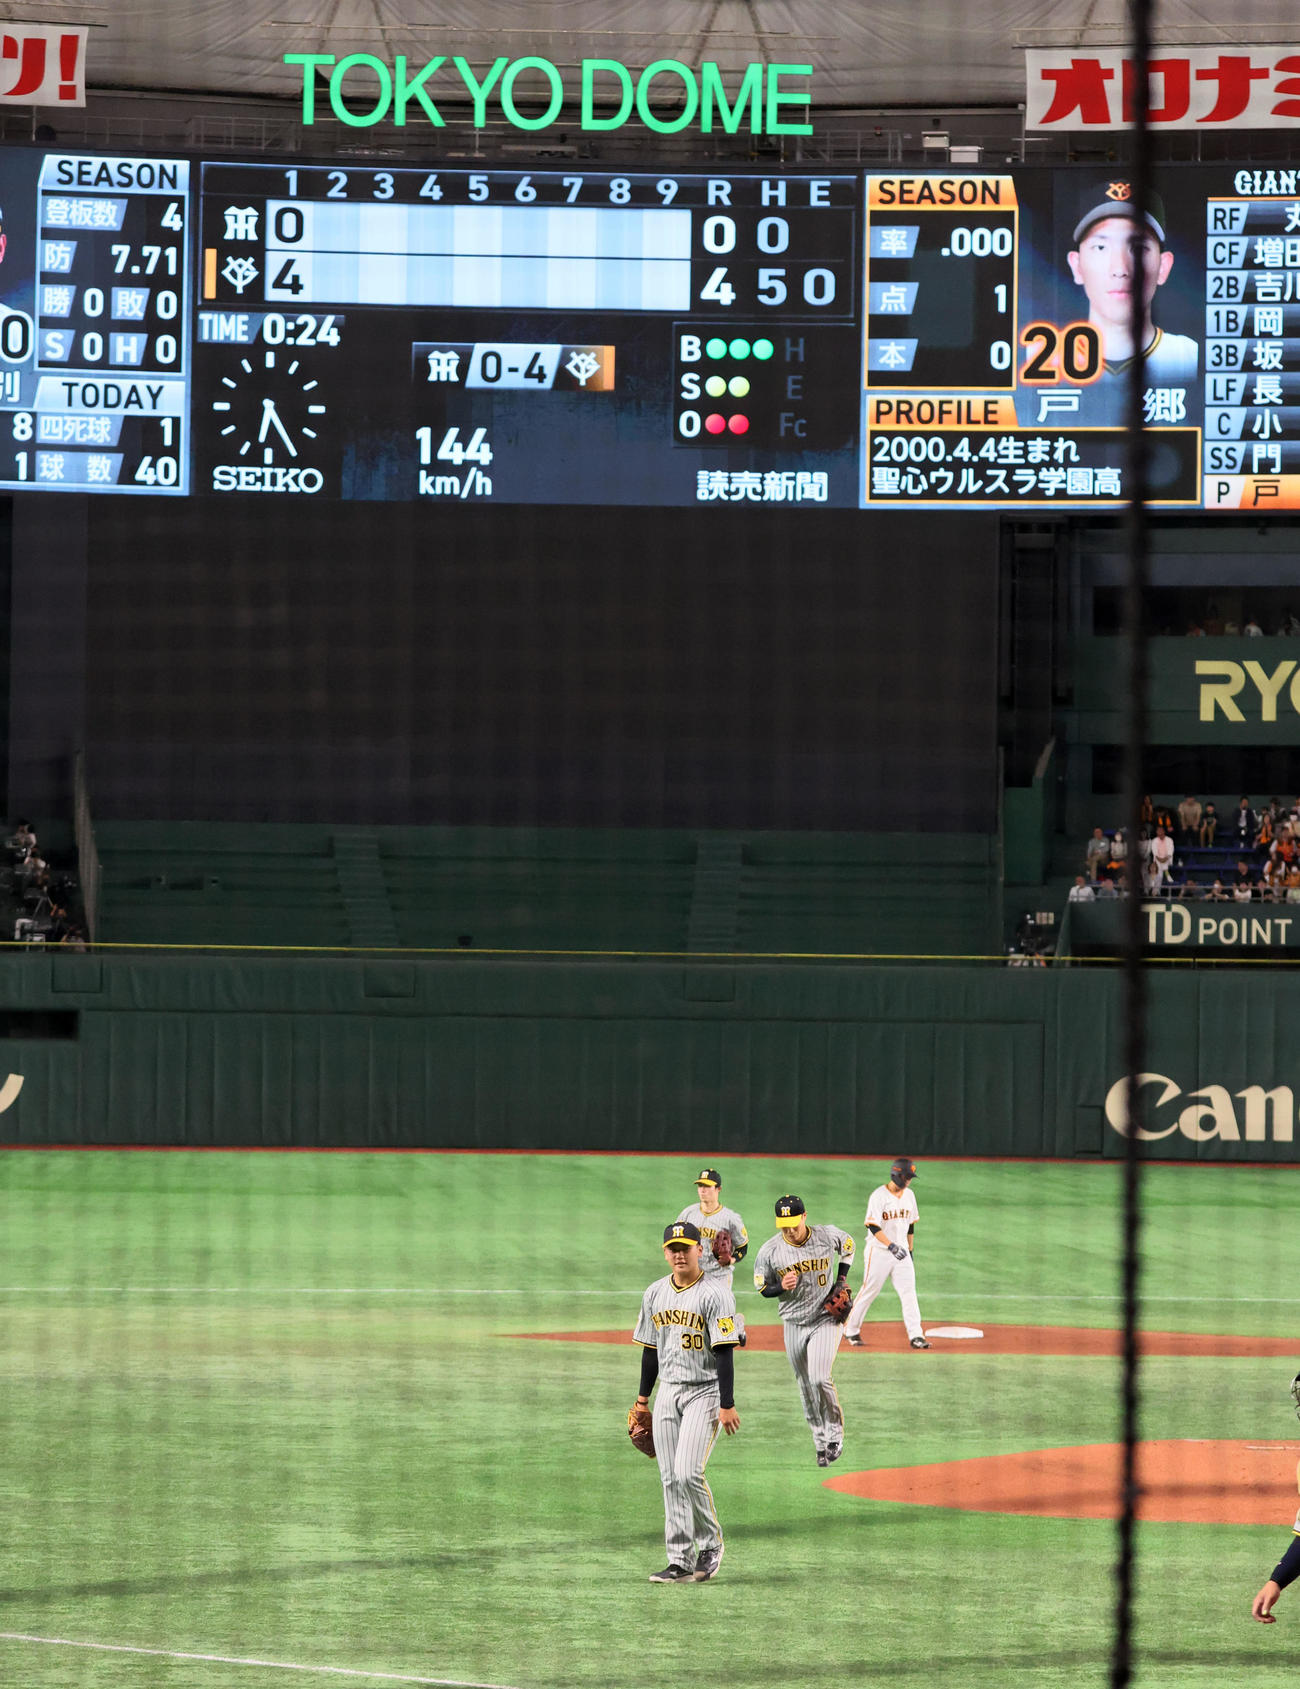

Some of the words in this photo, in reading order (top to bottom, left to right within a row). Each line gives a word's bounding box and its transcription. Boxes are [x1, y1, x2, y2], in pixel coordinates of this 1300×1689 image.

[283, 53, 563, 131] TOKYO
[581, 59, 813, 136] DOME
[56, 160, 178, 189] SEASON
[285, 170, 298, 196] 1
[327, 172, 348, 198] 2
[373, 173, 394, 199] 3
[419, 174, 443, 200] 4
[468, 175, 489, 201] 5
[514, 176, 537, 202] 6
[563, 177, 583, 203] 7
[609, 178, 632, 204] 8
[656, 179, 679, 205] 9
[708, 180, 732, 206] R
[761, 180, 787, 206] H
[810, 181, 831, 207] E
[1234, 170, 1300, 195] GIANT
[878, 180, 1000, 205] SEASON
[46, 201, 117, 226] 登板数
[161, 202, 183, 231] 4
[275, 206, 304, 243] 0
[703, 215, 736, 254] 0
[756, 216, 789, 254] 0
[1213, 208, 1240, 230] RF
[880, 229, 907, 255] 率
[941, 227, 1012, 257] .000
[1213, 242, 1240, 264] CF
[44, 243, 71, 270] 防
[111, 244, 177, 275] 7.71
[272, 259, 304, 295] 4
[700, 267, 736, 305] 4
[757, 268, 787, 306] 5
[803, 268, 836, 306] 0
[1212, 276, 1239, 298] 2B
[43, 287, 70, 315] 勝
[83, 288, 104, 317] 0
[116, 290, 144, 317] 敗
[156, 290, 178, 320] 0
[880, 285, 907, 311] 点
[994, 284, 1007, 313] 1
[199, 314, 249, 342] TIME
[262, 313, 341, 346] 0:24
[1213, 310, 1238, 333] 1B
[1254, 307, 1283, 337] 岡
[45, 333, 64, 359] S
[82, 332, 103, 361] 0
[116, 336, 137, 362] H
[155, 334, 177, 364] 0
[680, 334, 702, 362] B
[879, 341, 906, 368] 本
[990, 341, 1011, 370] 0
[1022, 324, 1101, 382] 20
[1211, 345, 1239, 367] 3B
[1254, 341, 1284, 371] 坂
[62, 382, 164, 409] TODAY
[680, 373, 702, 400] S
[1213, 378, 1237, 401] LF
[1253, 375, 1283, 405] 長
[875, 399, 999, 425] PROFILE
[1037, 389, 1082, 422] 戸
[13, 412, 33, 441] 8
[40, 415, 112, 443] 四死球
[160, 417, 173, 446] 1
[1217, 412, 1231, 435] C
[1252, 409, 1283, 439] 小
[416, 427, 493, 465] 144
[873, 436, 1080, 464] 2000.4.4生まれ
[1210, 447, 1237, 470] SS
[1252, 444, 1281, 474] 門
[15, 452, 28, 481] 1
[135, 455, 178, 485] 40
[213, 465, 323, 493] SEIKO
[872, 466, 1121, 495] 聖心ウルスラ学園高
[419, 467, 492, 499] km/h
[696, 470, 828, 501] 読売新聞
[1217, 481, 1230, 503] P
[1252, 479, 1281, 506] 戸
[1195, 660, 1300, 722] RY
[1140, 904, 1191, 944] TD
[1199, 918, 1292, 944] POINT
[1105, 1073, 1300, 1142] Can
[817, 1273, 827, 1288] 0
[682, 1333, 704, 1351] 30
